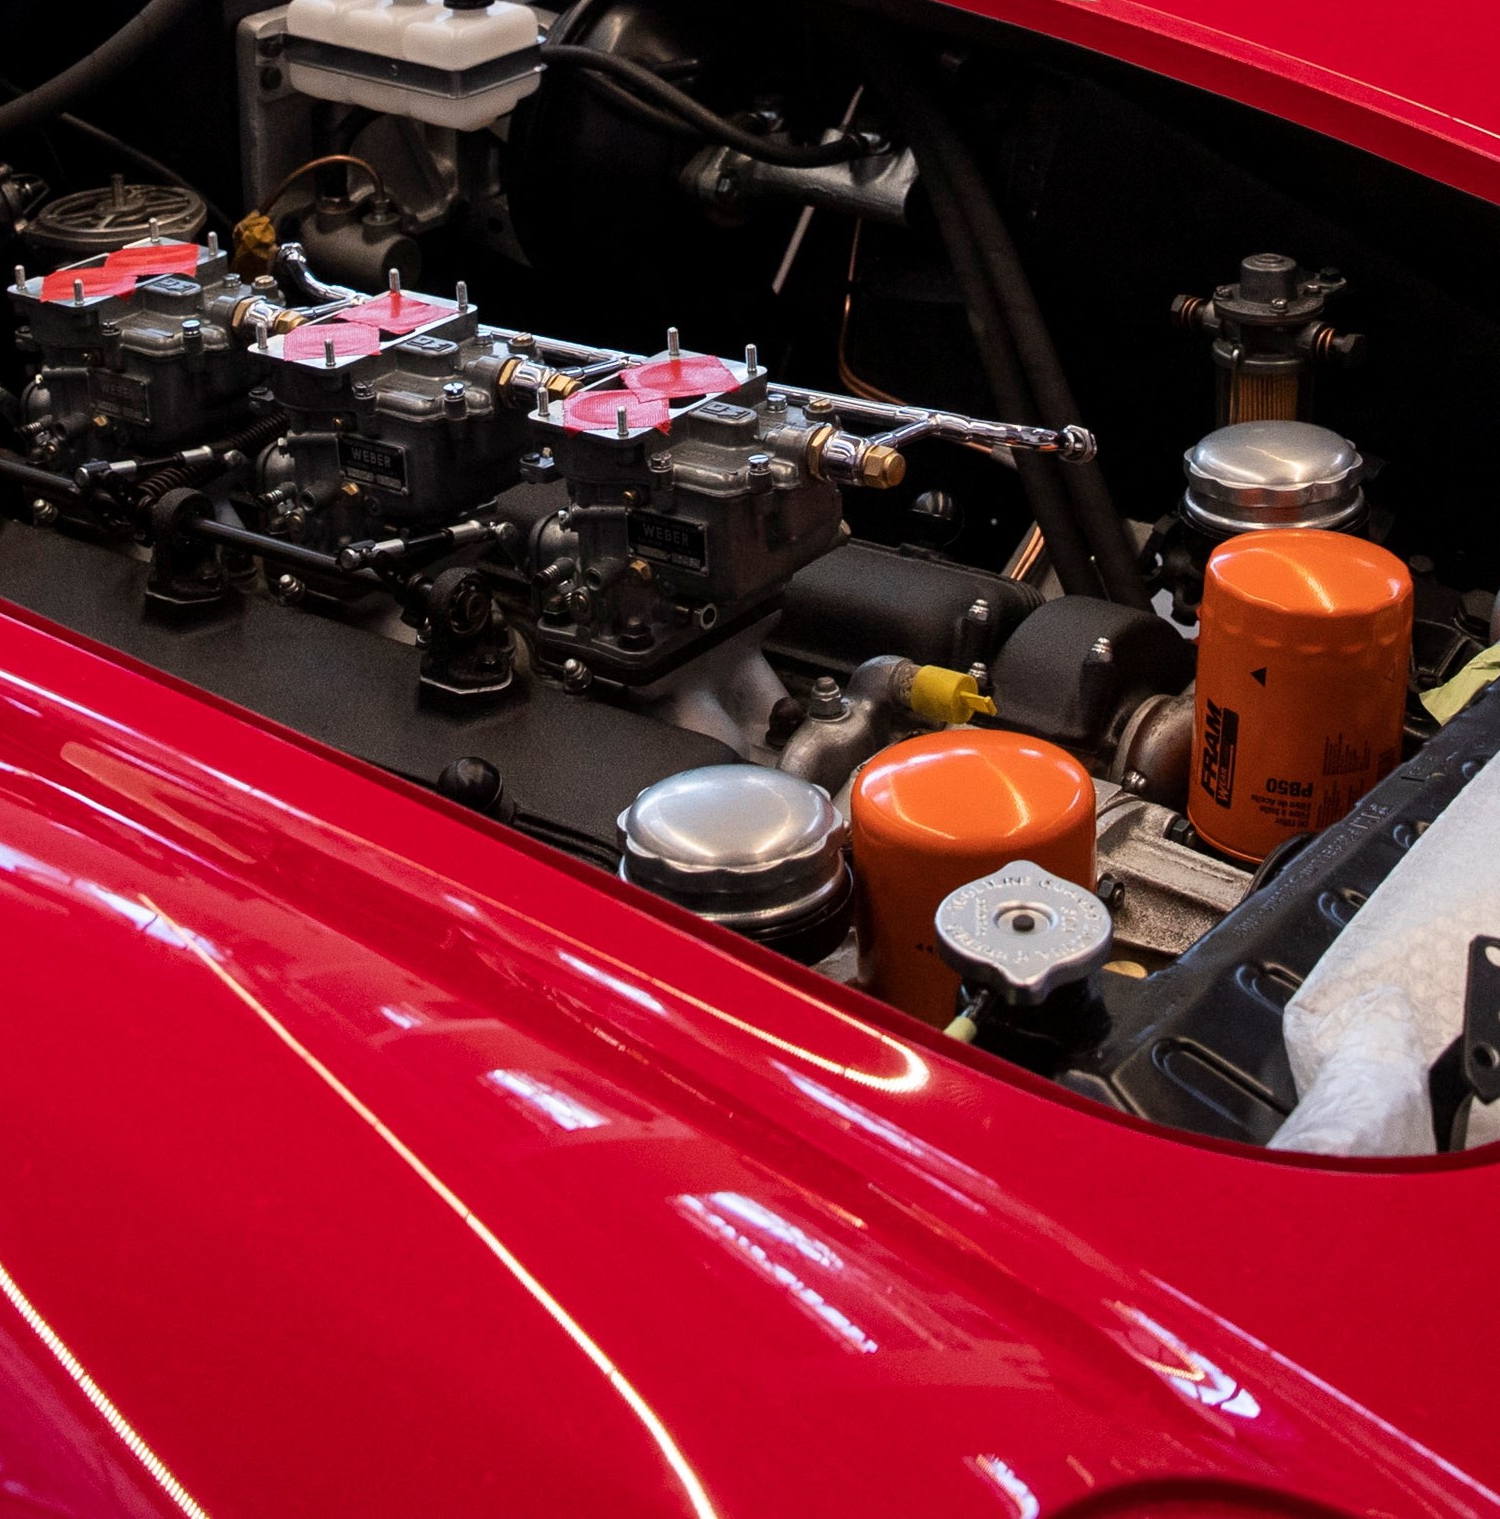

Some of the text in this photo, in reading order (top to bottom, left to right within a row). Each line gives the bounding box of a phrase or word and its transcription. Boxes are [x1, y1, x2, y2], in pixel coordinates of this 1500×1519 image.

[350, 446, 392, 469] WEBER
[642, 522, 690, 547] WEBER
[1201, 698, 1222, 798] FRAM
[1266, 778, 1314, 798] PB50
